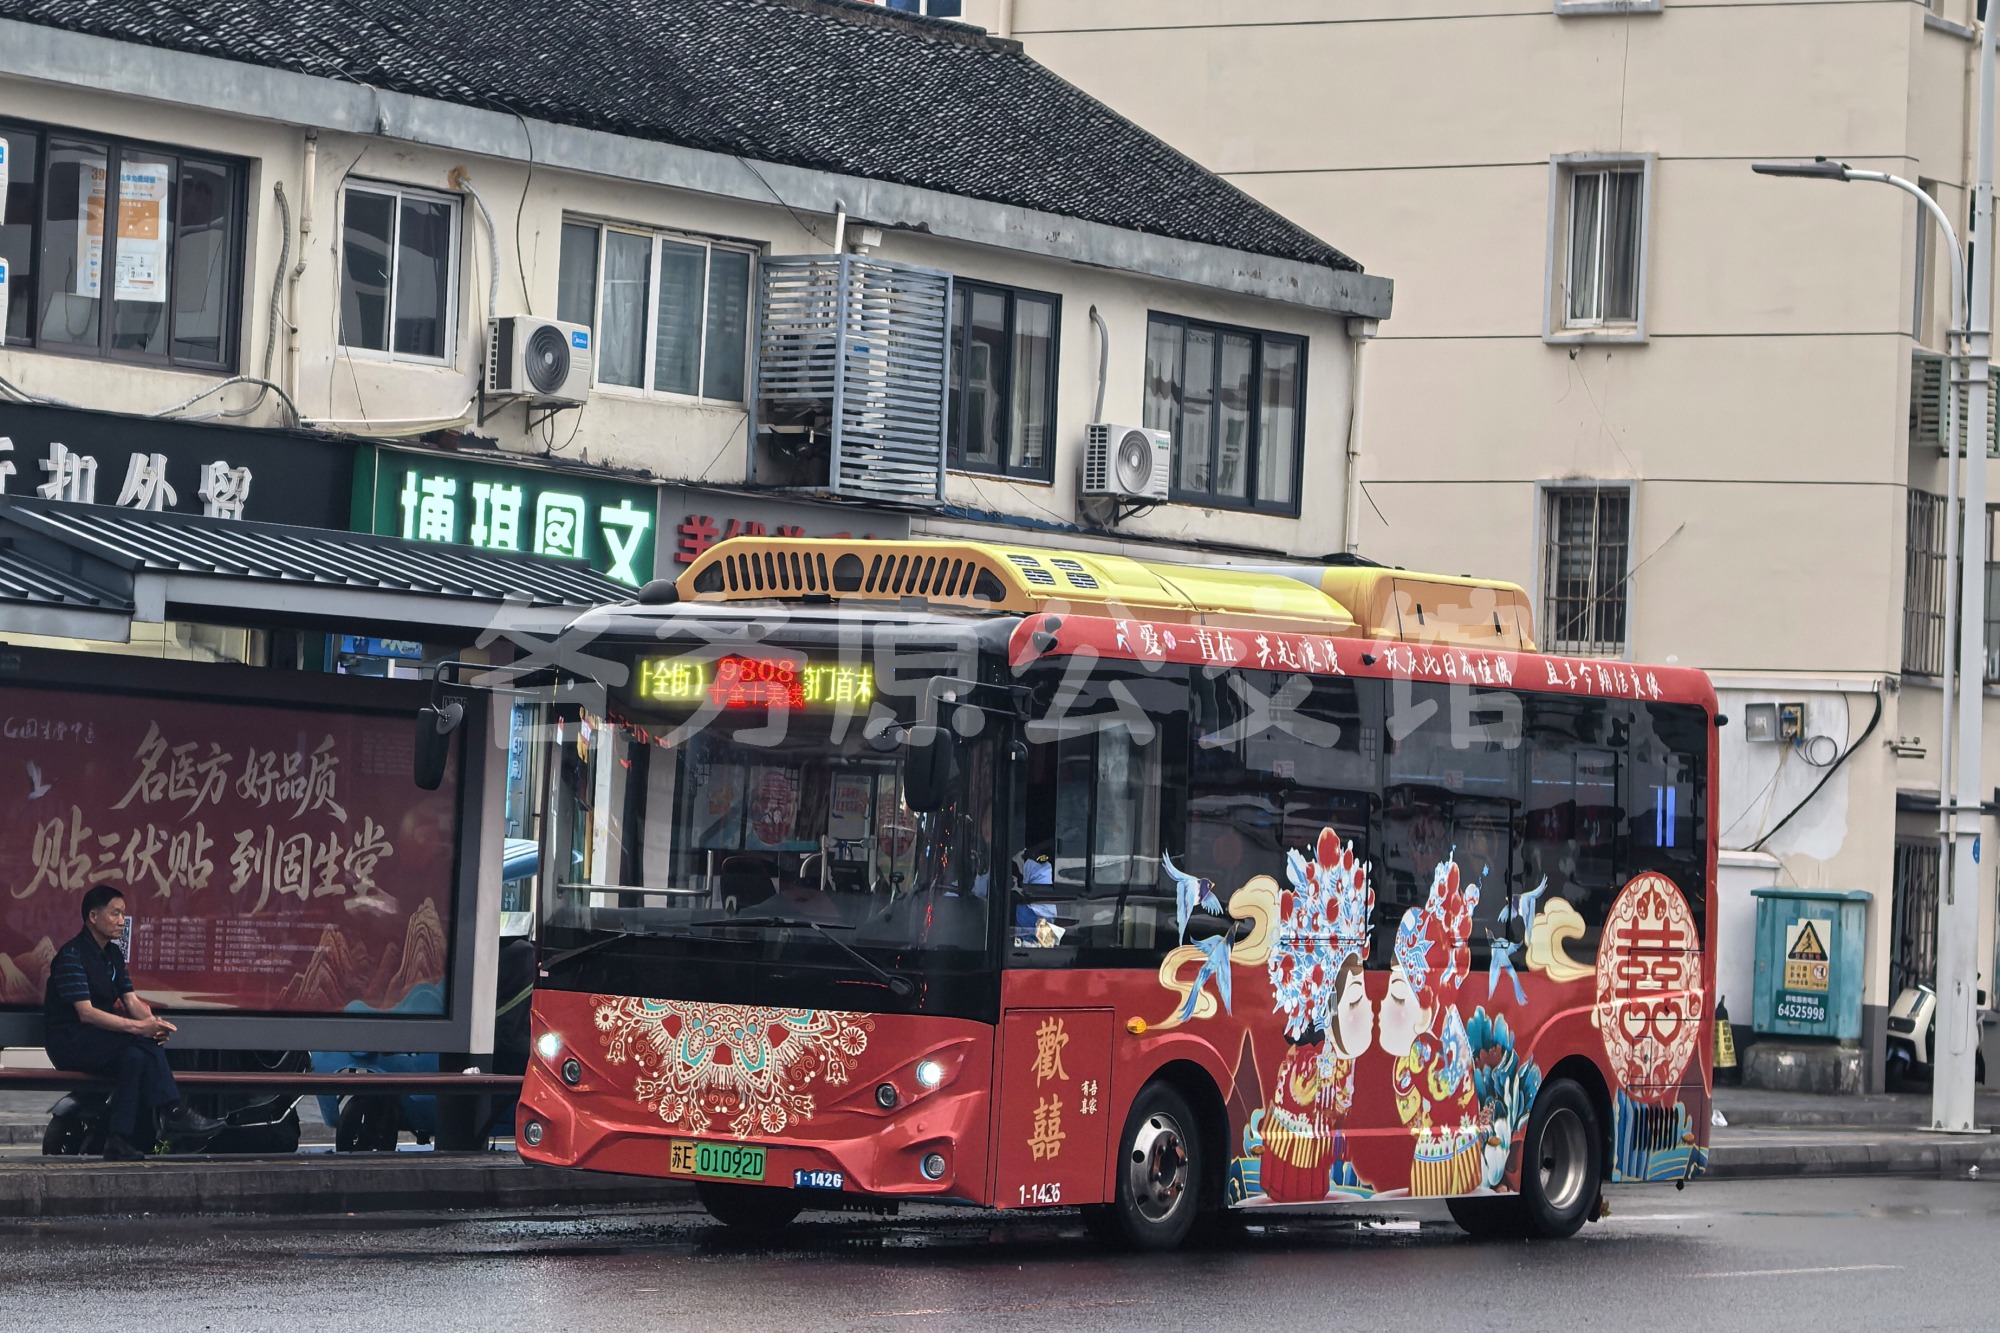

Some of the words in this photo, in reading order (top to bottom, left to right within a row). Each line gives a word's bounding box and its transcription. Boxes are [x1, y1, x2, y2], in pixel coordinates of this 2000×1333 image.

[0, 437, 252, 520] 扣外贸
[1255, 633, 1346, 676] 共赴浪漫
[108, 724, 233, 822] 名医方
[236, 734, 348, 823] 好品质
[11, 804, 215, 900] 贴三伏贴
[229, 816, 398, 917] 到固生堂
[1777, 1003, 1825, 1021] 64525998
